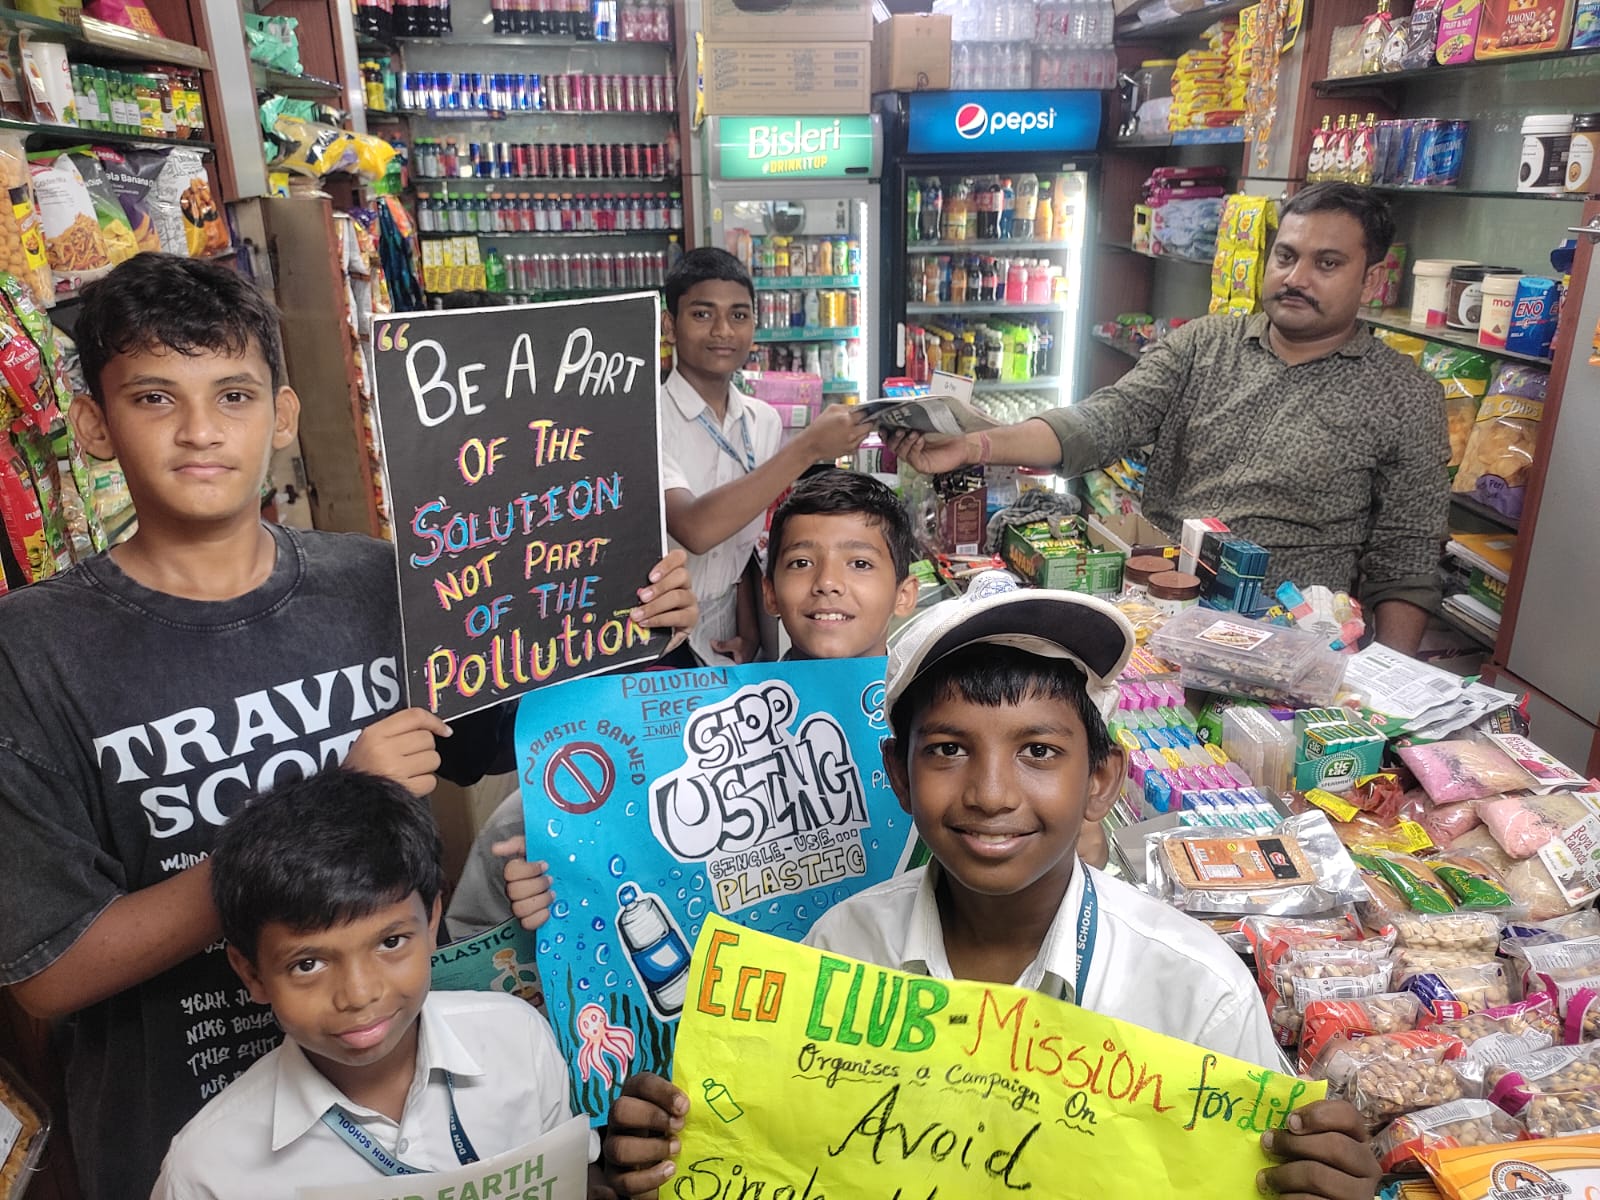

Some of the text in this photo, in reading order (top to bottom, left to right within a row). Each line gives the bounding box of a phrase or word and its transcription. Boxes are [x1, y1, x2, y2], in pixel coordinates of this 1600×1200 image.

[1505, 11, 1536, 25] ALMOND
[748, 119, 842, 160] Bisleri
[990, 107, 1057, 134] pepsi
[1514, 300, 1545, 318] ENO
[506, 333, 537, 400] A
[554, 327, 646, 397] PART
[456, 418, 594, 486] OF THE
[410, 472, 623, 569] SOLUTION
[433, 538, 611, 611] NOT PART
[464, 575, 602, 638] OF THE
[621, 668, 728, 699] POLLUTION
[641, 695, 704, 721] FREE
[93, 655, 400, 784] TRAVIS
[642, 720, 682, 737] INDIA
[688, 686, 793, 769] STOP
[530, 719, 647, 786] PLASTIC BANNED
[1327, 766, 1348, 776] tac
[1333, 760, 1350, 770] tic
[655, 717, 868, 860] USING
[1572, 824, 1598, 852] Royal
[430, 926, 515, 968] PLASTIC
[186, 1018, 227, 1045] NIKE
[805, 954, 950, 1054] CLUB
[962, 988, 1176, 1113] Mission
[1182, 1053, 1244, 1132] for
[186, 1047, 231, 1077] THIS
[915, 1066, 932, 1079] a
[945, 1063, 1041, 1112] Campaign
[1063, 1090, 1098, 1125] On
[338, 1112, 396, 1169] HIGH SCHOOL,
[828, 1083, 1042, 1191] Avoid
